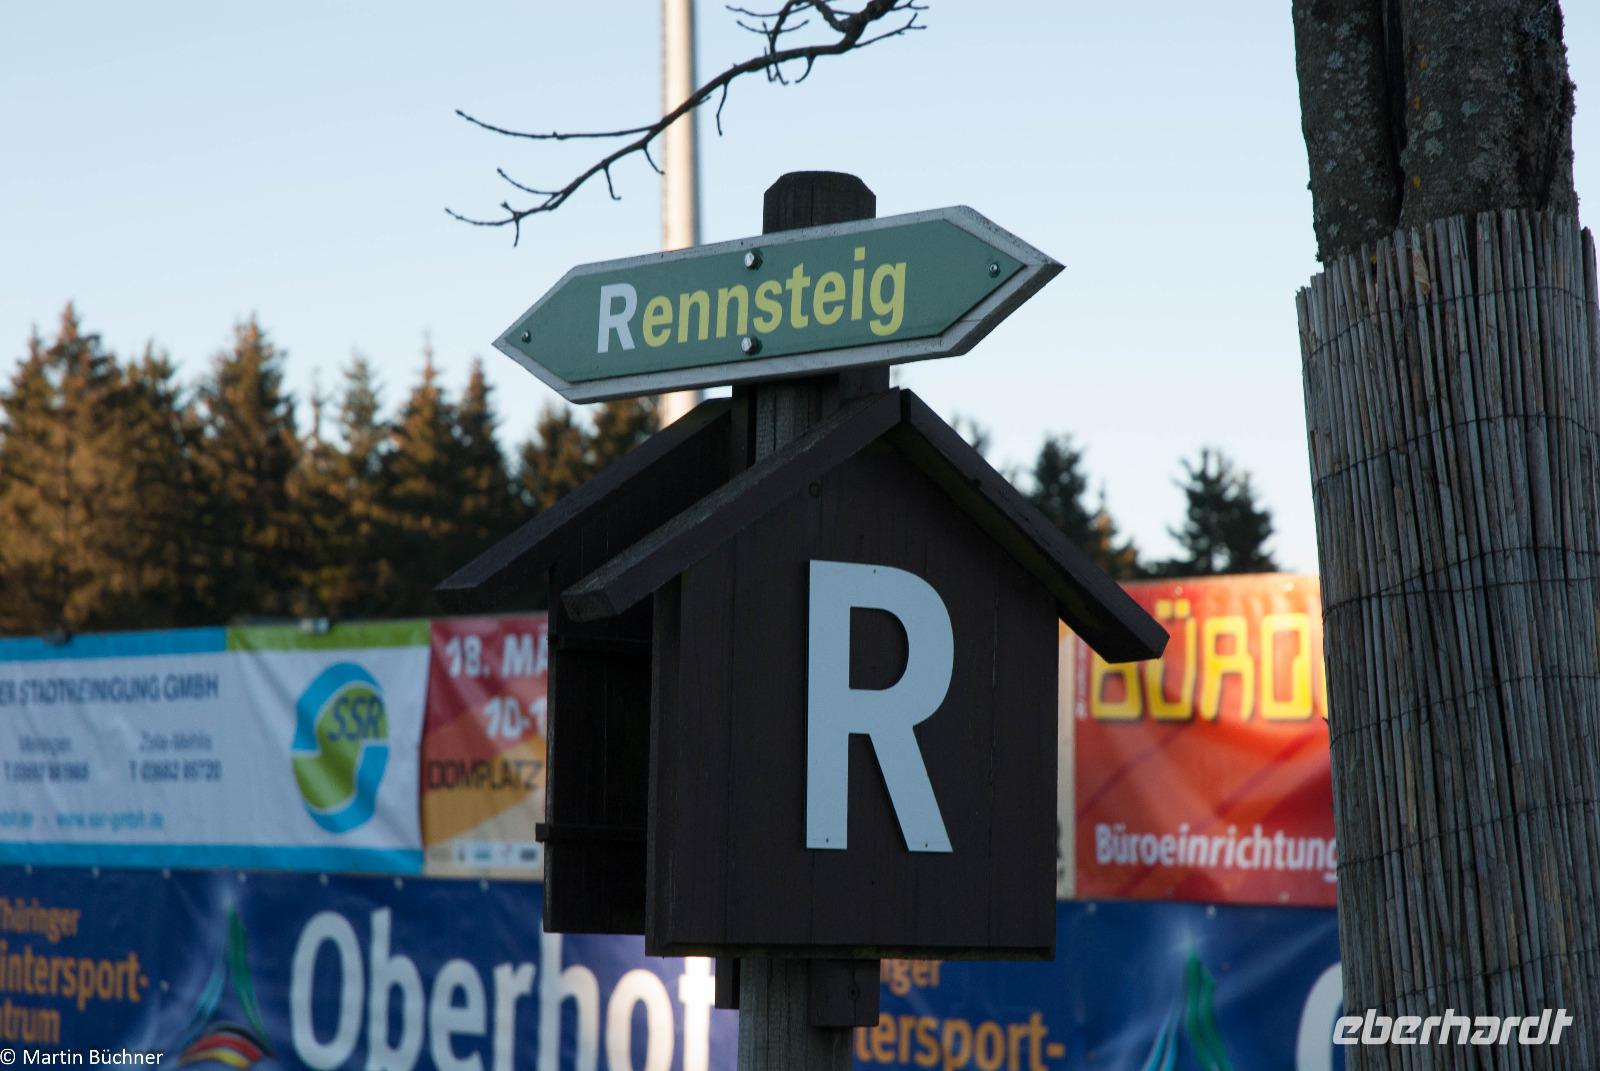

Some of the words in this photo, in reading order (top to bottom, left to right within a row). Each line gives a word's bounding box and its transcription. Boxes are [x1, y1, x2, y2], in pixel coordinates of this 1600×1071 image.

[596, 247, 907, 353] Rennsteig
[445, 633, 491, 679] 18.
[1091, 598, 1328, 720] BÜRO
[163, 672, 219, 702] GMBH
[806, 560, 955, 852] R
[326, 694, 386, 742] SSR
[427, 758, 544, 790] DOMPLATZ
[1093, 821, 1338, 882] Büroeinrichtung
